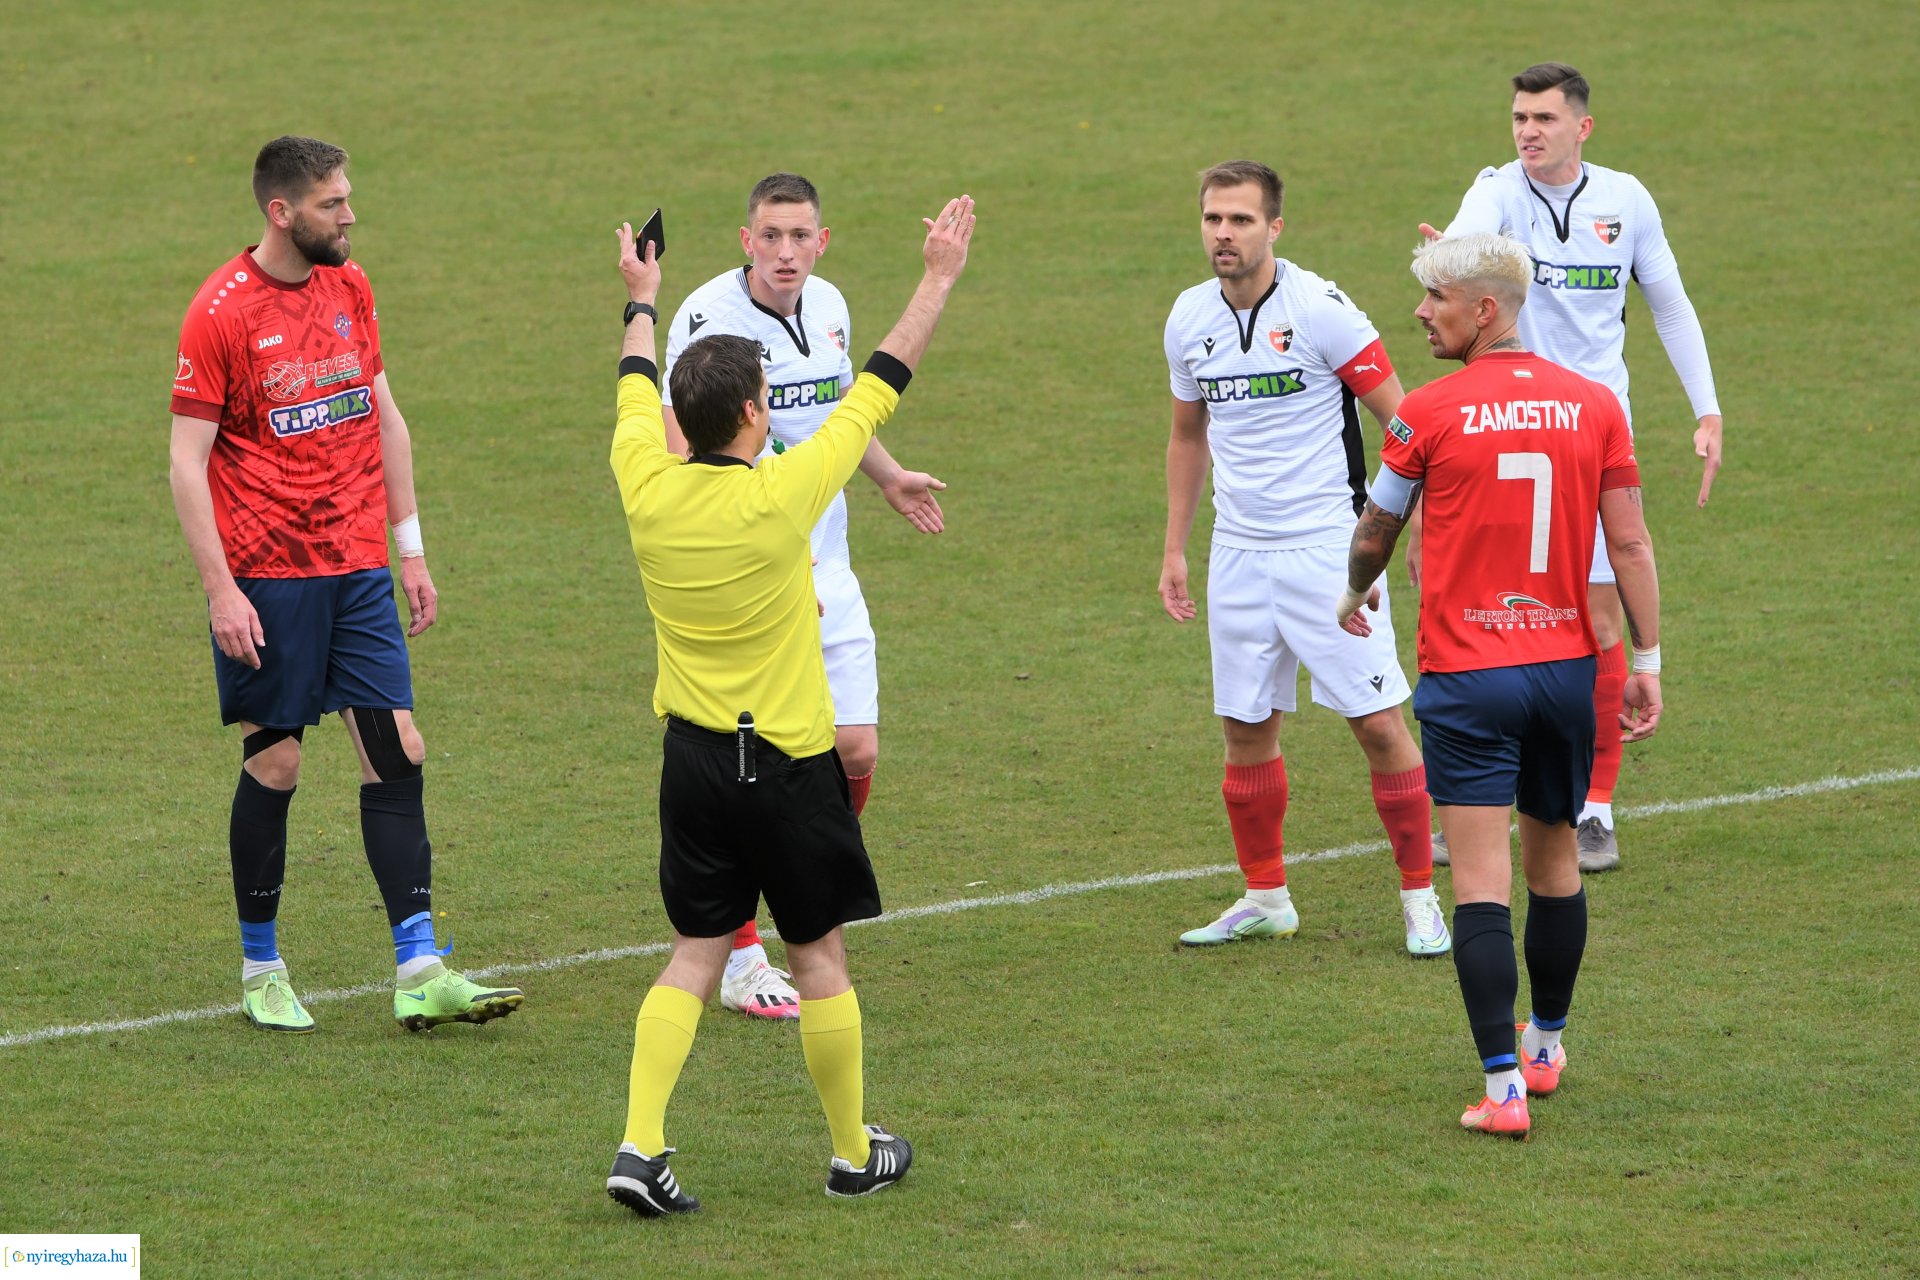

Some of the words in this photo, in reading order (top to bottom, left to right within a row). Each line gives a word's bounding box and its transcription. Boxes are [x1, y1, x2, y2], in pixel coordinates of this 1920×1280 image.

[1531, 262, 1619, 287] PPMIX
[258, 334, 283, 349] JAKO
[768, 379, 839, 407] iPPMI
[1460, 400, 1582, 435] ZAMOSTNY
[1497, 452, 1553, 574] 7
[1527, 608, 1578, 621] TRANS
[249, 883, 283, 897] JAKO
